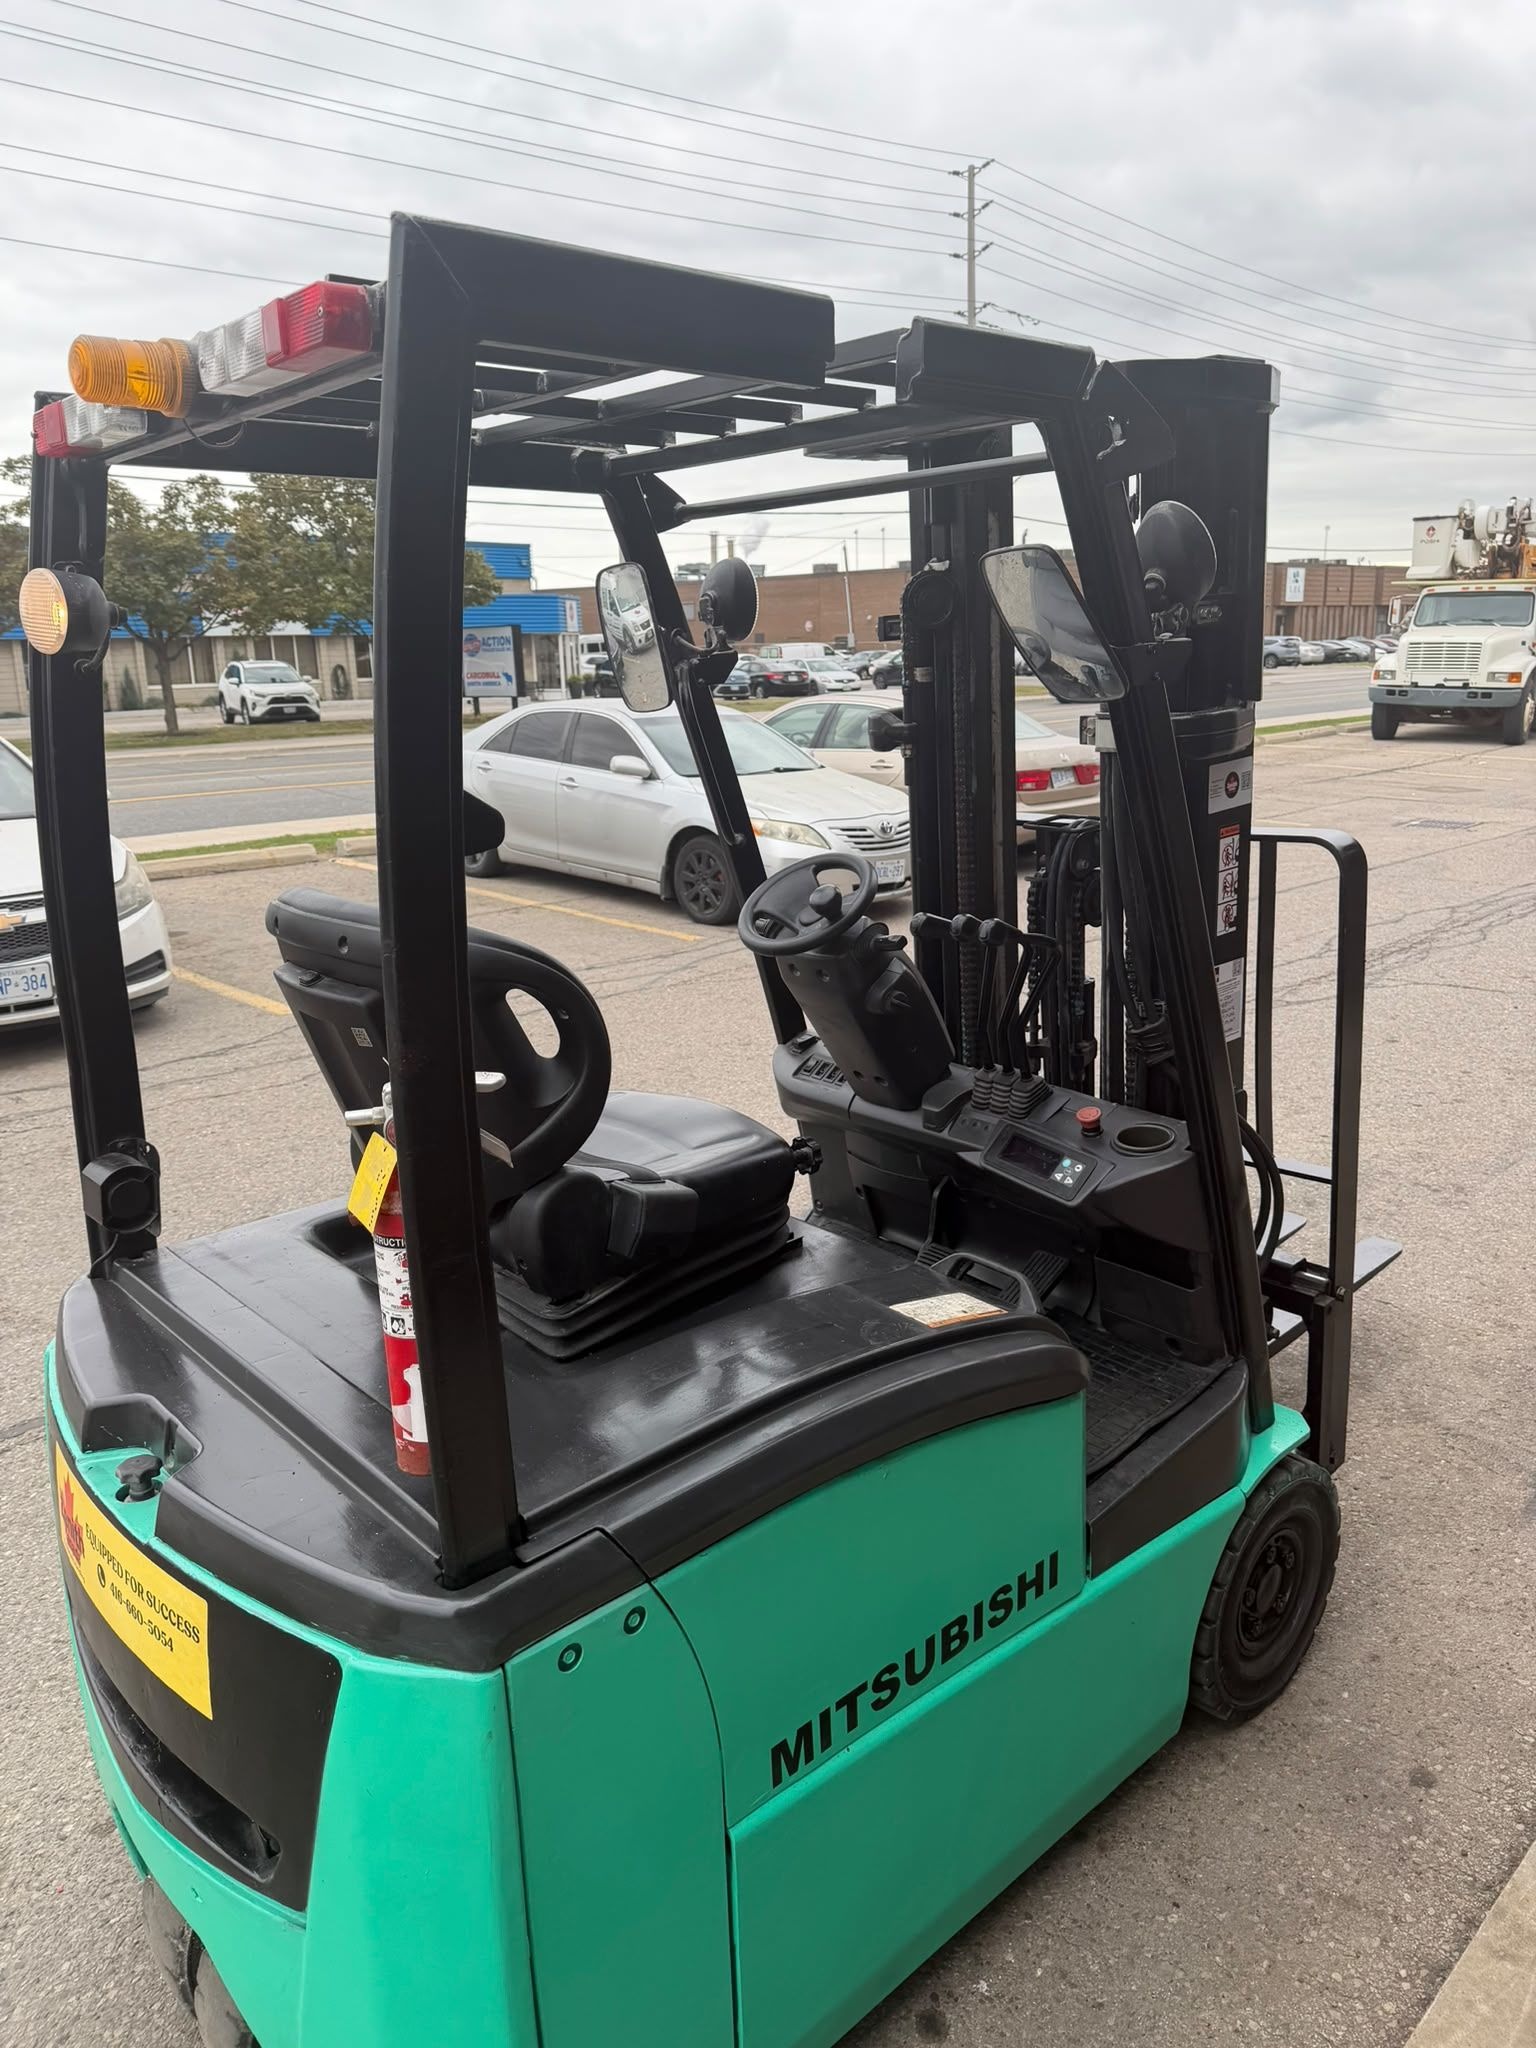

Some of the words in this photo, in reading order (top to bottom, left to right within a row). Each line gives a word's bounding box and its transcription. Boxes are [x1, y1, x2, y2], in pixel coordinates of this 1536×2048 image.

[481, 636, 511, 647] ACTION
[21, 973, 48, 992] 384
[85, 1522, 124, 1579] EQUIPPED
[125, 1569, 145, 1602] FOR
[146, 1590, 200, 1644] SUCCESS
[770, 1550, 1059, 1789] MITSUBISHI
